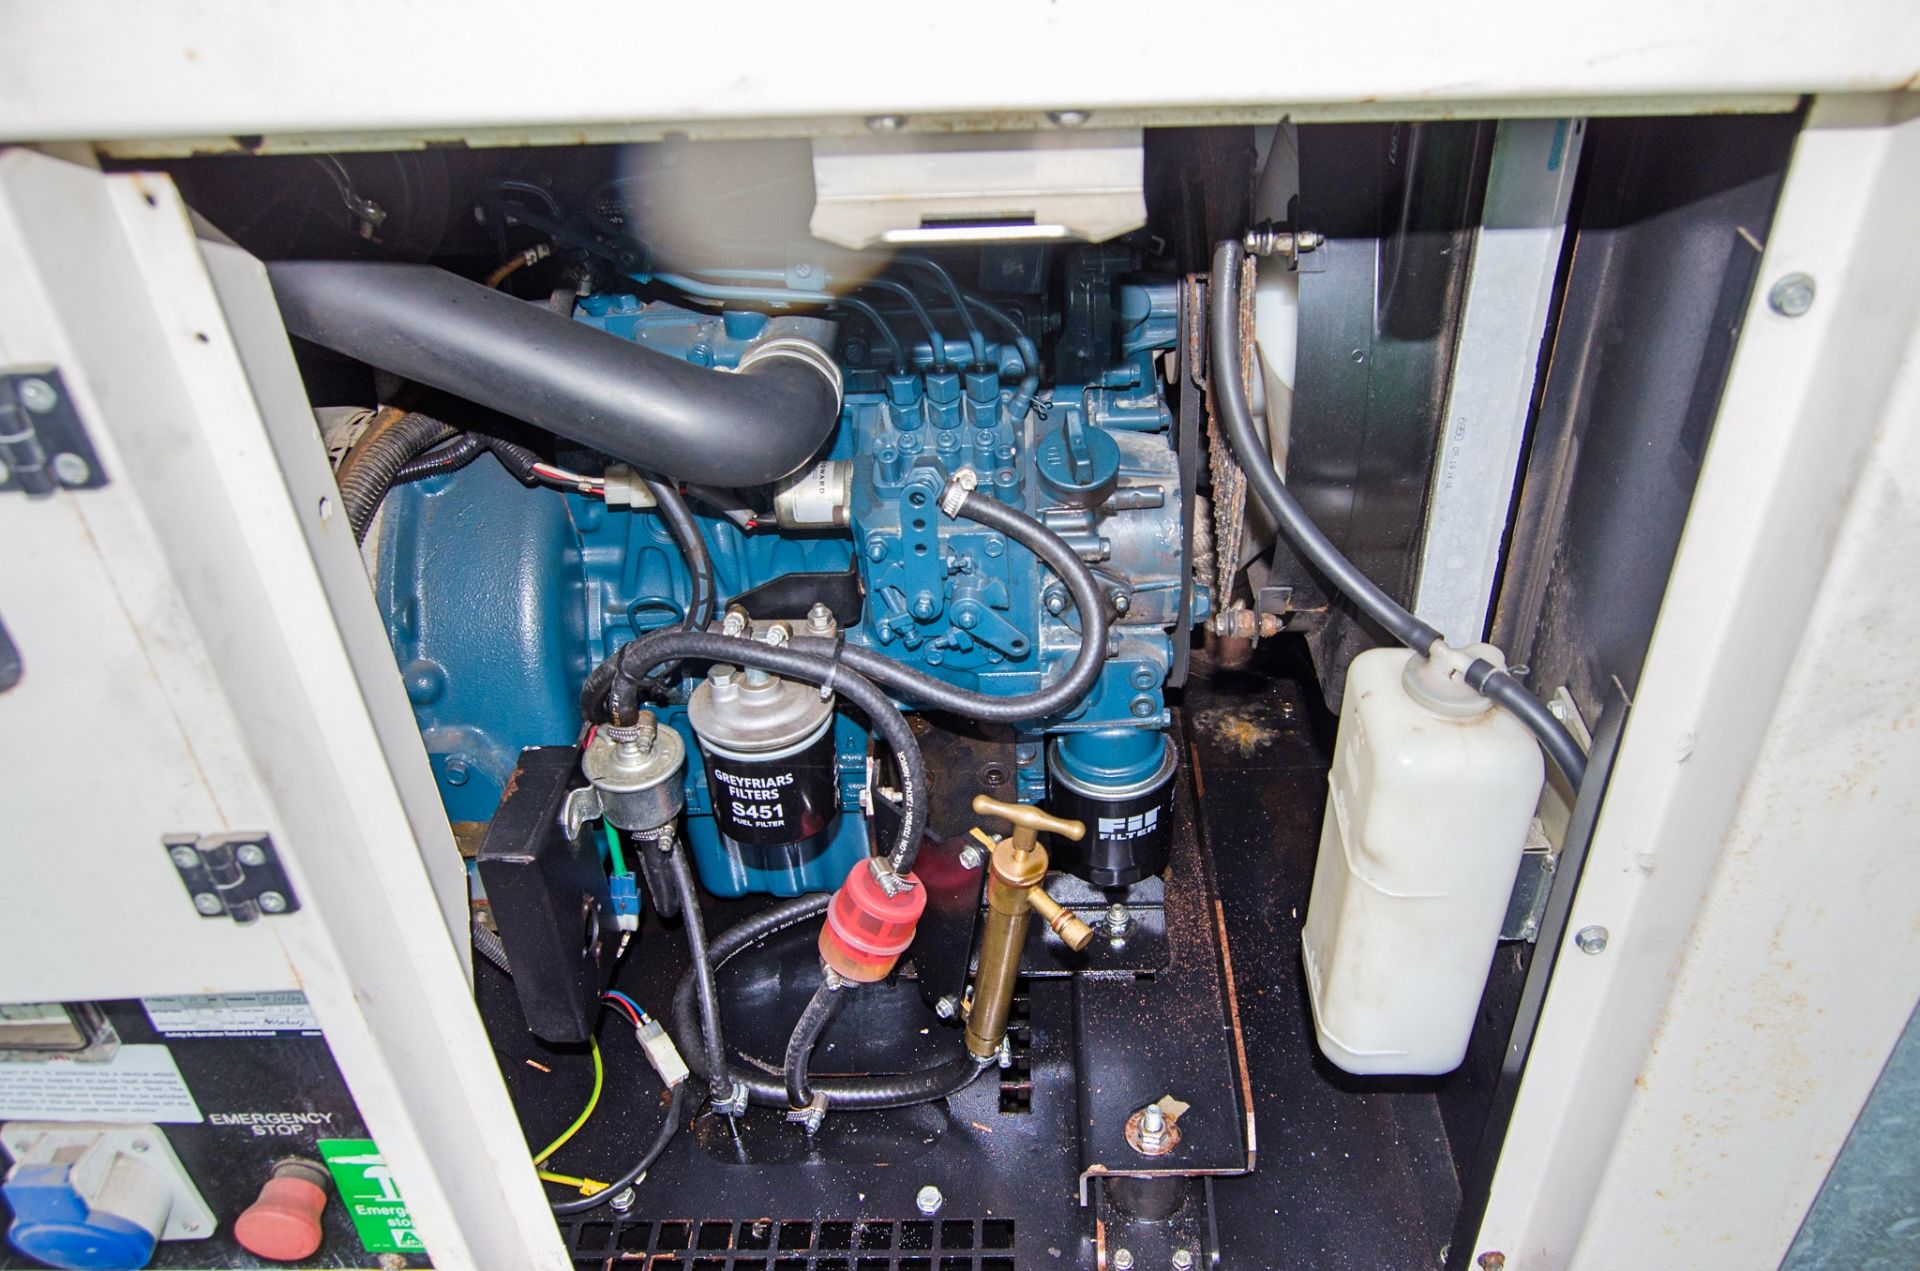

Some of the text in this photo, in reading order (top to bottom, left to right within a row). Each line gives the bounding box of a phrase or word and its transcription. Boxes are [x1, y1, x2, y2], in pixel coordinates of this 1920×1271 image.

[714, 769, 794, 789] GREYFRIARS
[729, 785, 780, 800] FILTERS
[731, 801, 783, 819] S451
[732, 816, 785, 828] FUEL FILTER
[1099, 823, 1157, 841] FILTER
[209, 1112, 333, 1125] EMERGENCY
[251, 1124, 304, 1136] STOP
[355, 1204, 408, 1218] Emerg
[387, 1217, 416, 1228] sto
